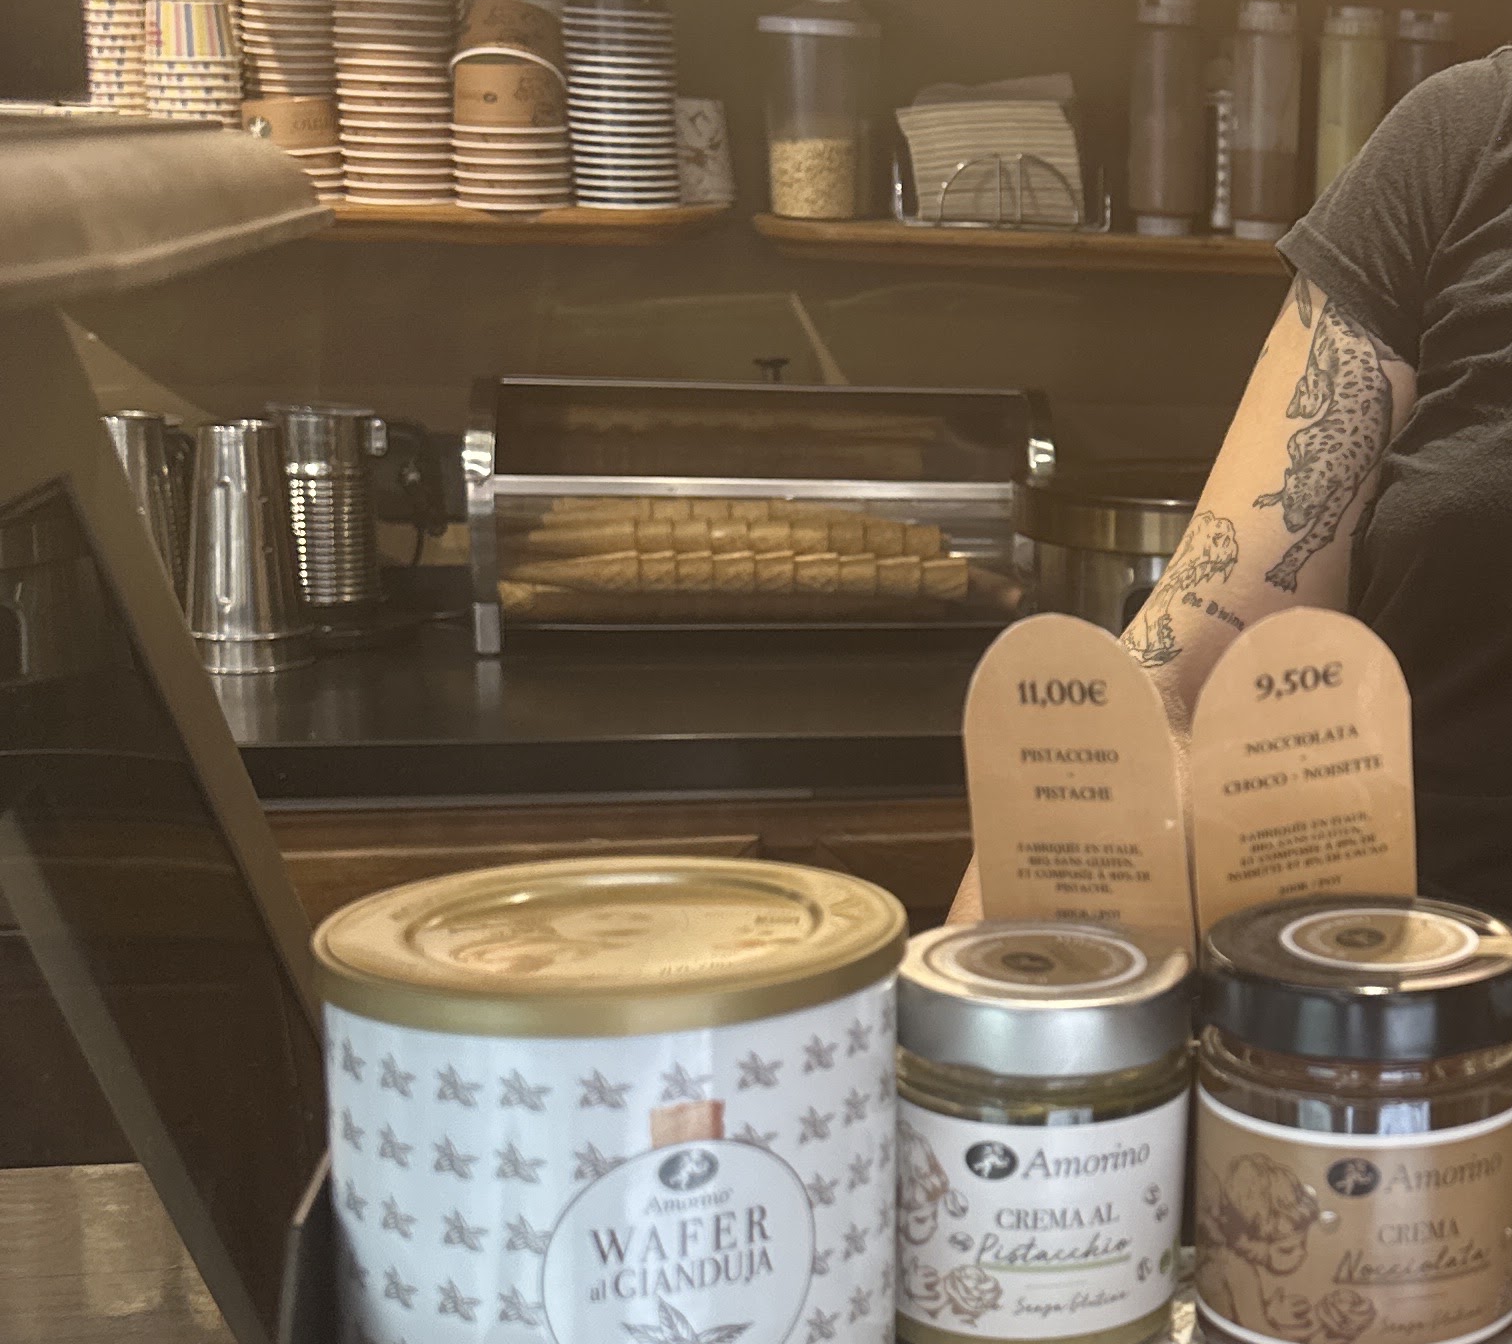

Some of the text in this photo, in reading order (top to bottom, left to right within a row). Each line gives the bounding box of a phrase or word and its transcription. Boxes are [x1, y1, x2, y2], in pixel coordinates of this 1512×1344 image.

[1017, 679, 1108, 709] 11,00€
[1255, 661, 1343, 702] 9,50€
[1020, 748, 1119, 765] PISTACCHIO
[1246, 724, 1359, 756] NOCCIOLATA
[1224, 755, 1382, 796] CHOCO NOISETTE
[1035, 786, 1112, 802] PISTACHE
[1021, 1142, 1150, 1180] Amorino
[1384, 1152, 1502, 1194] Amorino
[995, 1201, 1120, 1230] CREMA AL
[590, 1205, 771, 1265] WAFER
[1378, 1218, 1459, 1247] CREMA
[976, 1233, 1132, 1266] Pistacchio
[590, 1247, 774, 1301] al GIANDUJA
